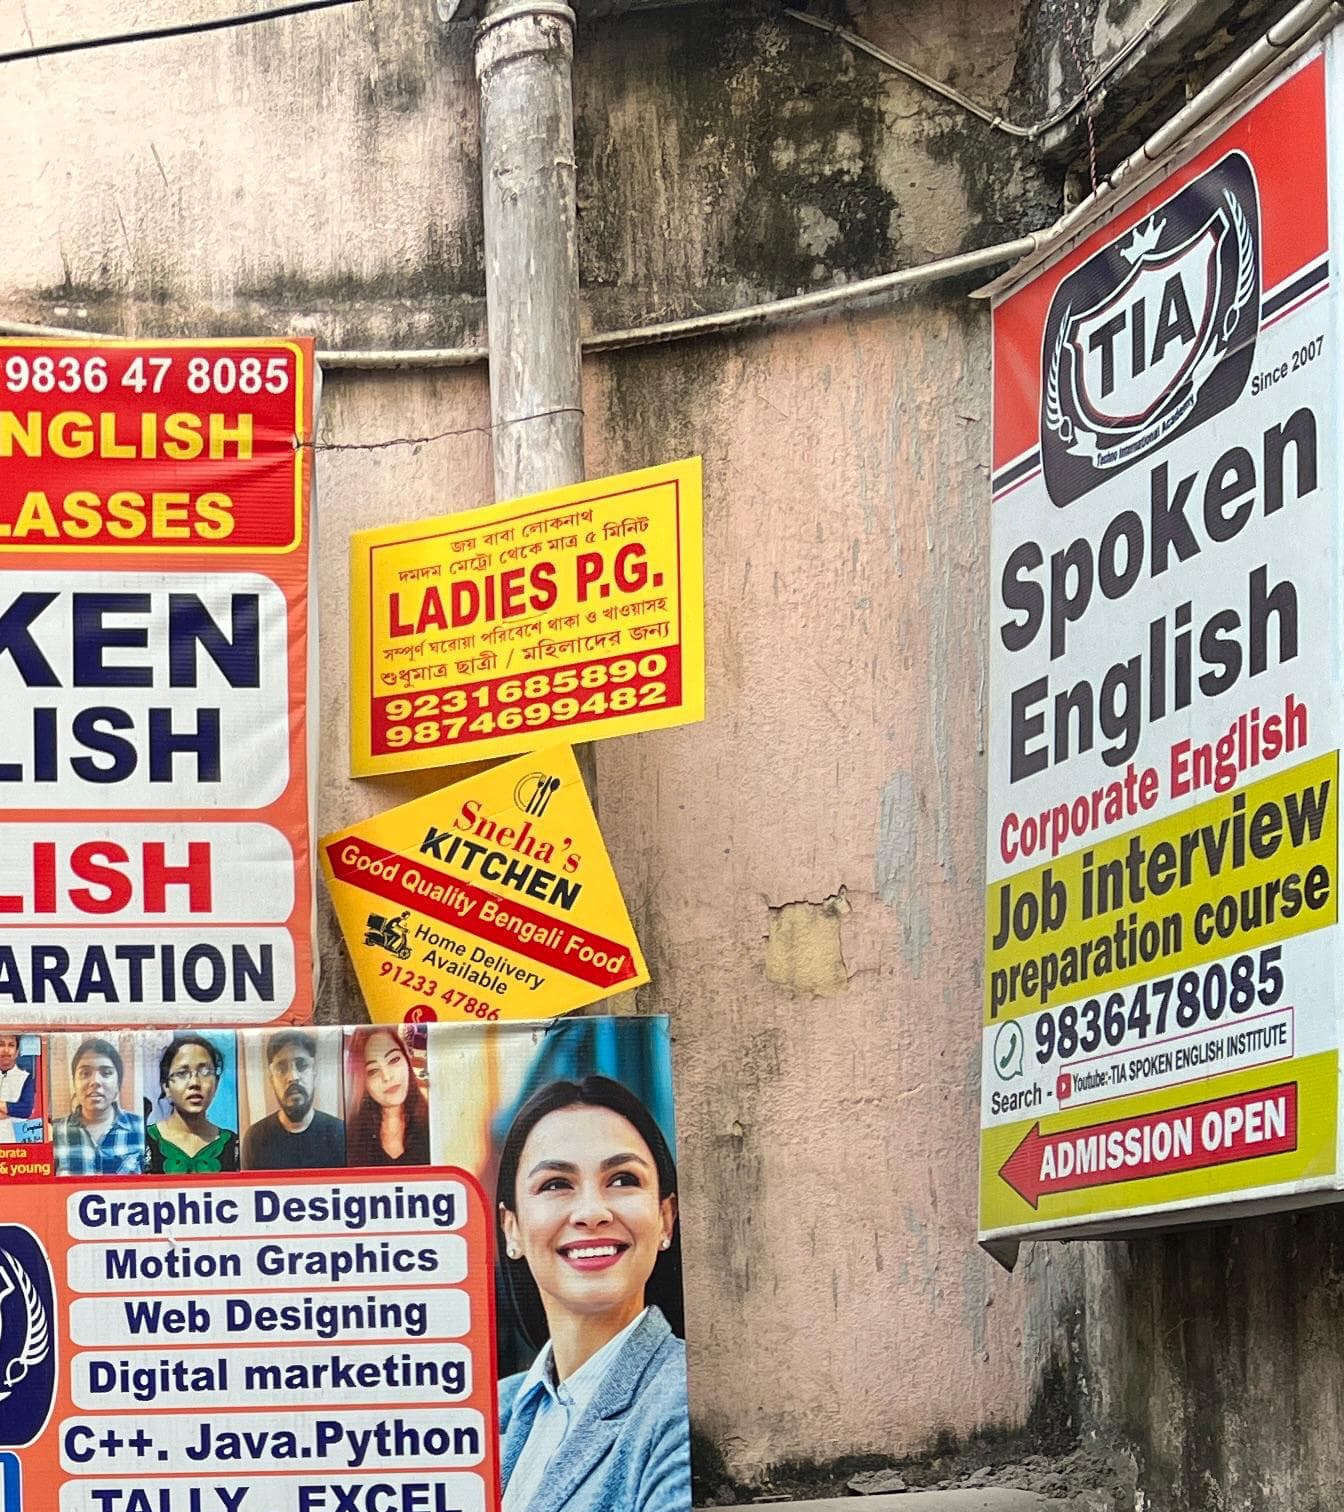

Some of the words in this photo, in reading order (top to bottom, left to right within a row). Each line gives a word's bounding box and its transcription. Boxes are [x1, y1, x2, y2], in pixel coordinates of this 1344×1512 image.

[1089, 271, 1198, 398] TIA
[5, 357, 108, 395] 9836
[122, 358, 172, 394] 47
[187, 358, 289, 395] 8085
[1000, 406, 1318, 660] Spoken
[389, 561, 558, 639] LADIES
[576, 542, 663, 602] P.G.
[385, 654, 668, 721] 9231685890
[1010, 564, 1298, 784] English
[386, 682, 666, 748] 9874699482
[419, 827, 583, 911] KITCHEN
[340, 845, 398, 882] Good
[401, 870, 477, 917] Quality
[479, 902, 565, 950] Bengali
[564, 936, 625, 974] Food
[414, 924, 467, 957] Home
[469, 947, 545, 990] Delivery
[422, 951, 508, 995] Available
[1034, 945, 1284, 1065] 9836478085
[1039, 1119, 1194, 1181] ADMISSION
[1201, 1096, 1286, 1152] OPEN
[77, 1193, 245, 1229] Graphic
[254, 1186, 457, 1229] Designing
[105, 1249, 247, 1280] Motion
[255, 1243, 440, 1277] Graphics
[124, 1300, 211, 1334] Web
[225, 1297, 428, 1341] Designing
[89, 1359, 229, 1398] Digital
[244, 1355, 467, 1394] marketing
